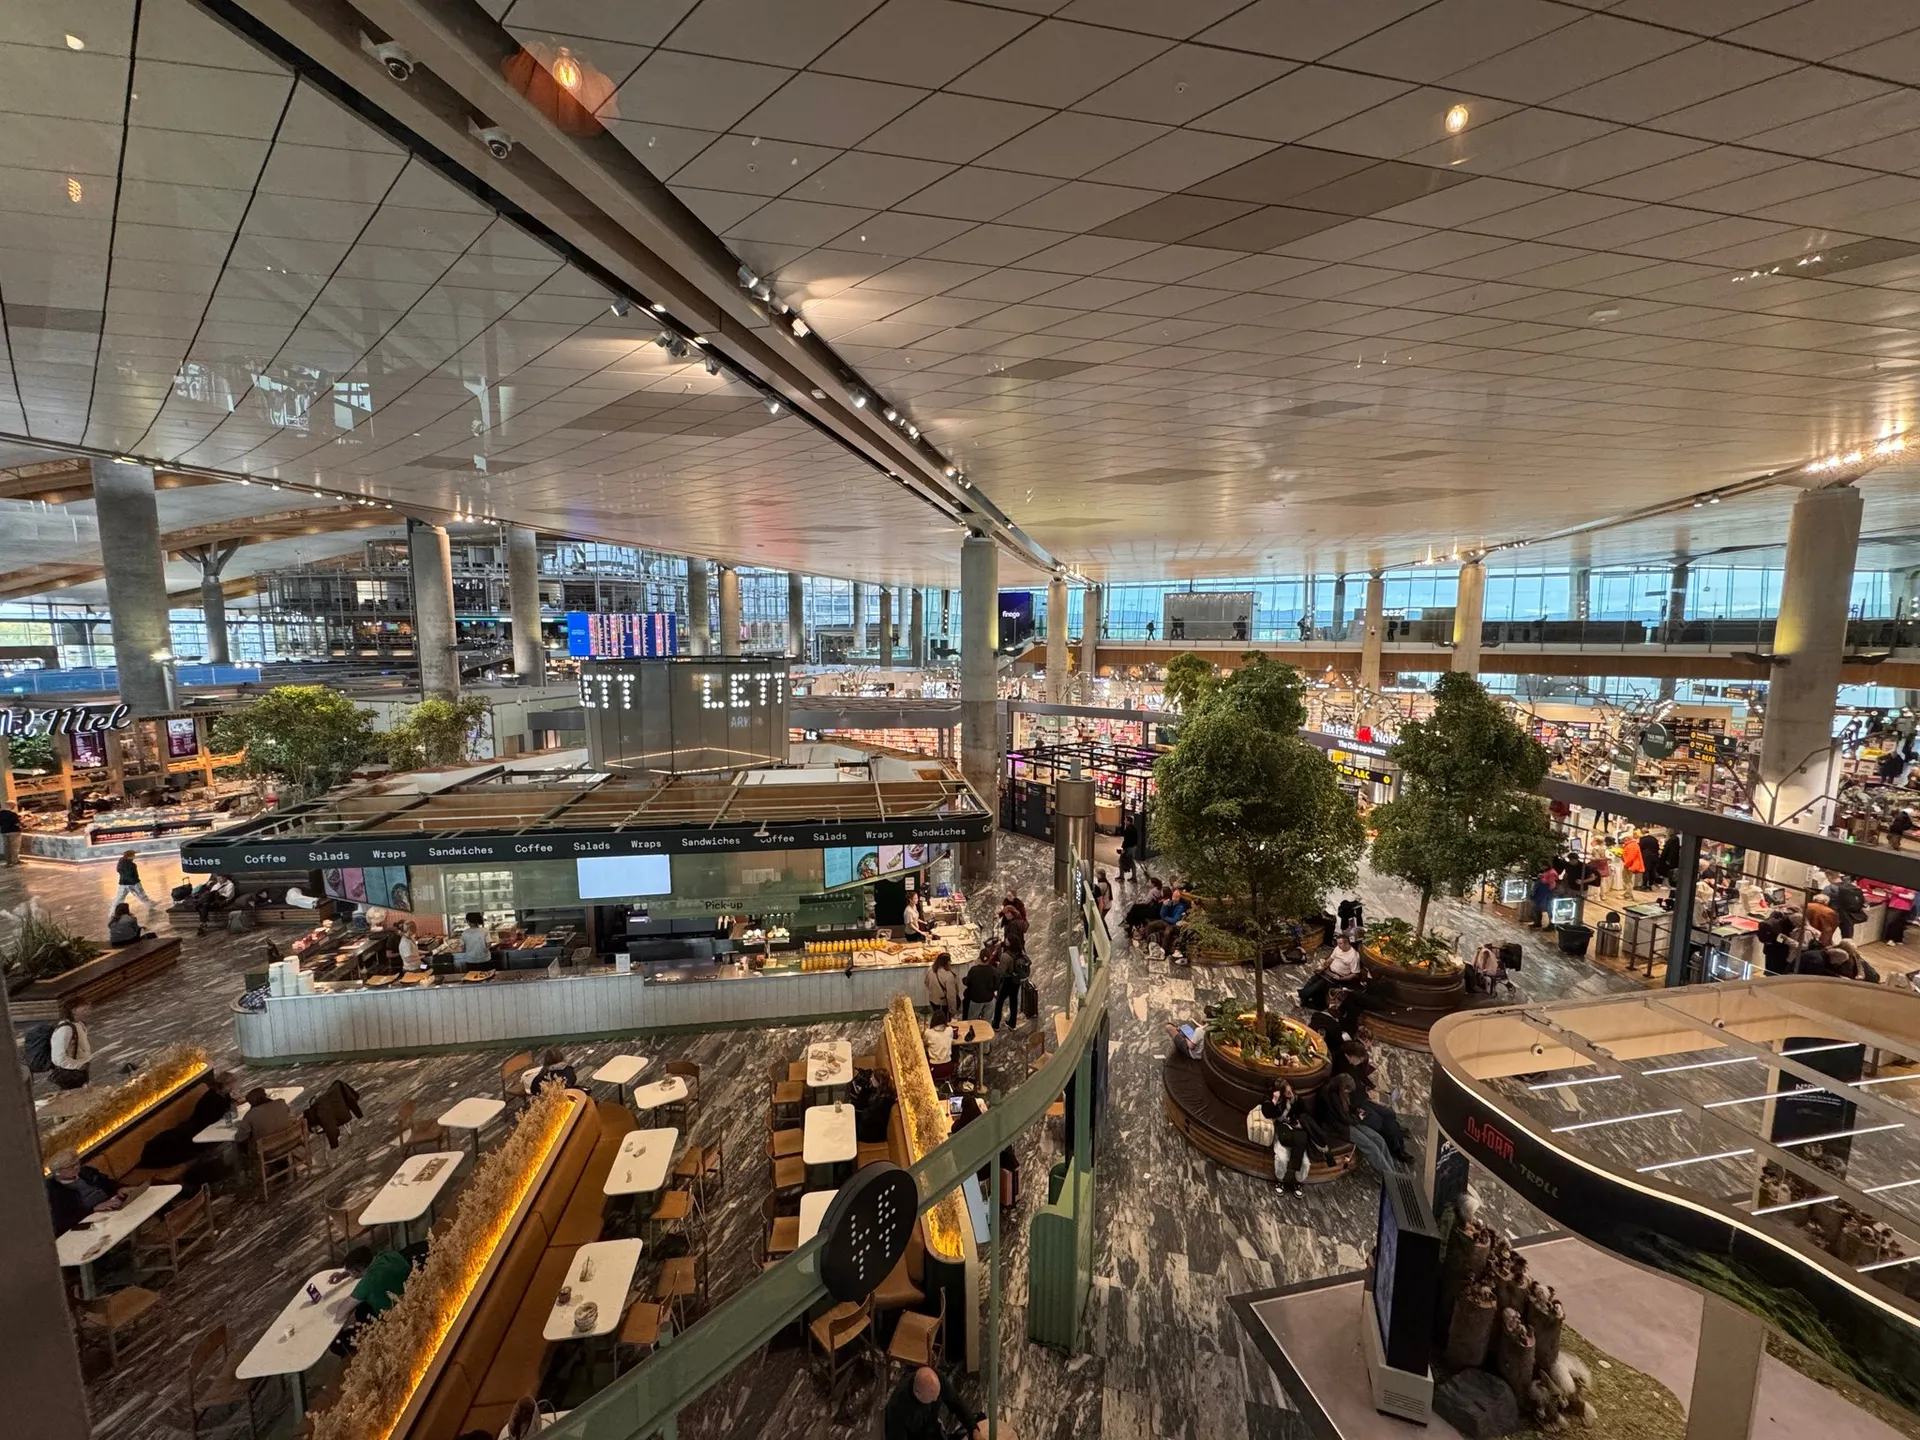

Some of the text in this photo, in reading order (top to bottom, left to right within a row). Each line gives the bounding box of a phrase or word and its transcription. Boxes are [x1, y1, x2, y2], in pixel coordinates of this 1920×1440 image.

[702, 672, 786, 709] LETT
[40, 703, 132, 737] Mel
[1321, 722, 1335, 734] Tax
[1335, 724, 1355, 738] Free
[1338, 740, 1347, 748] The
[244, 854, 287, 864] Coffee
[308, 851, 350, 862] Salads
[372, 849, 407, 859] Wraps
[428, 846, 494, 857] Sandwiches
[514, 843, 553, 853] Coffee
[573, 841, 611, 851] Salads
[630, 839, 662, 850] Wraps
[681, 836, 741, 847] Sandwiches
[813, 832, 847, 841] Salads
[865, 830, 894, 840] Wraps
[911, 827, 967, 837] Sandwiches
[705, 900, 743, 911] Pick-up
[1519, 1163, 1559, 1199] TROLL
